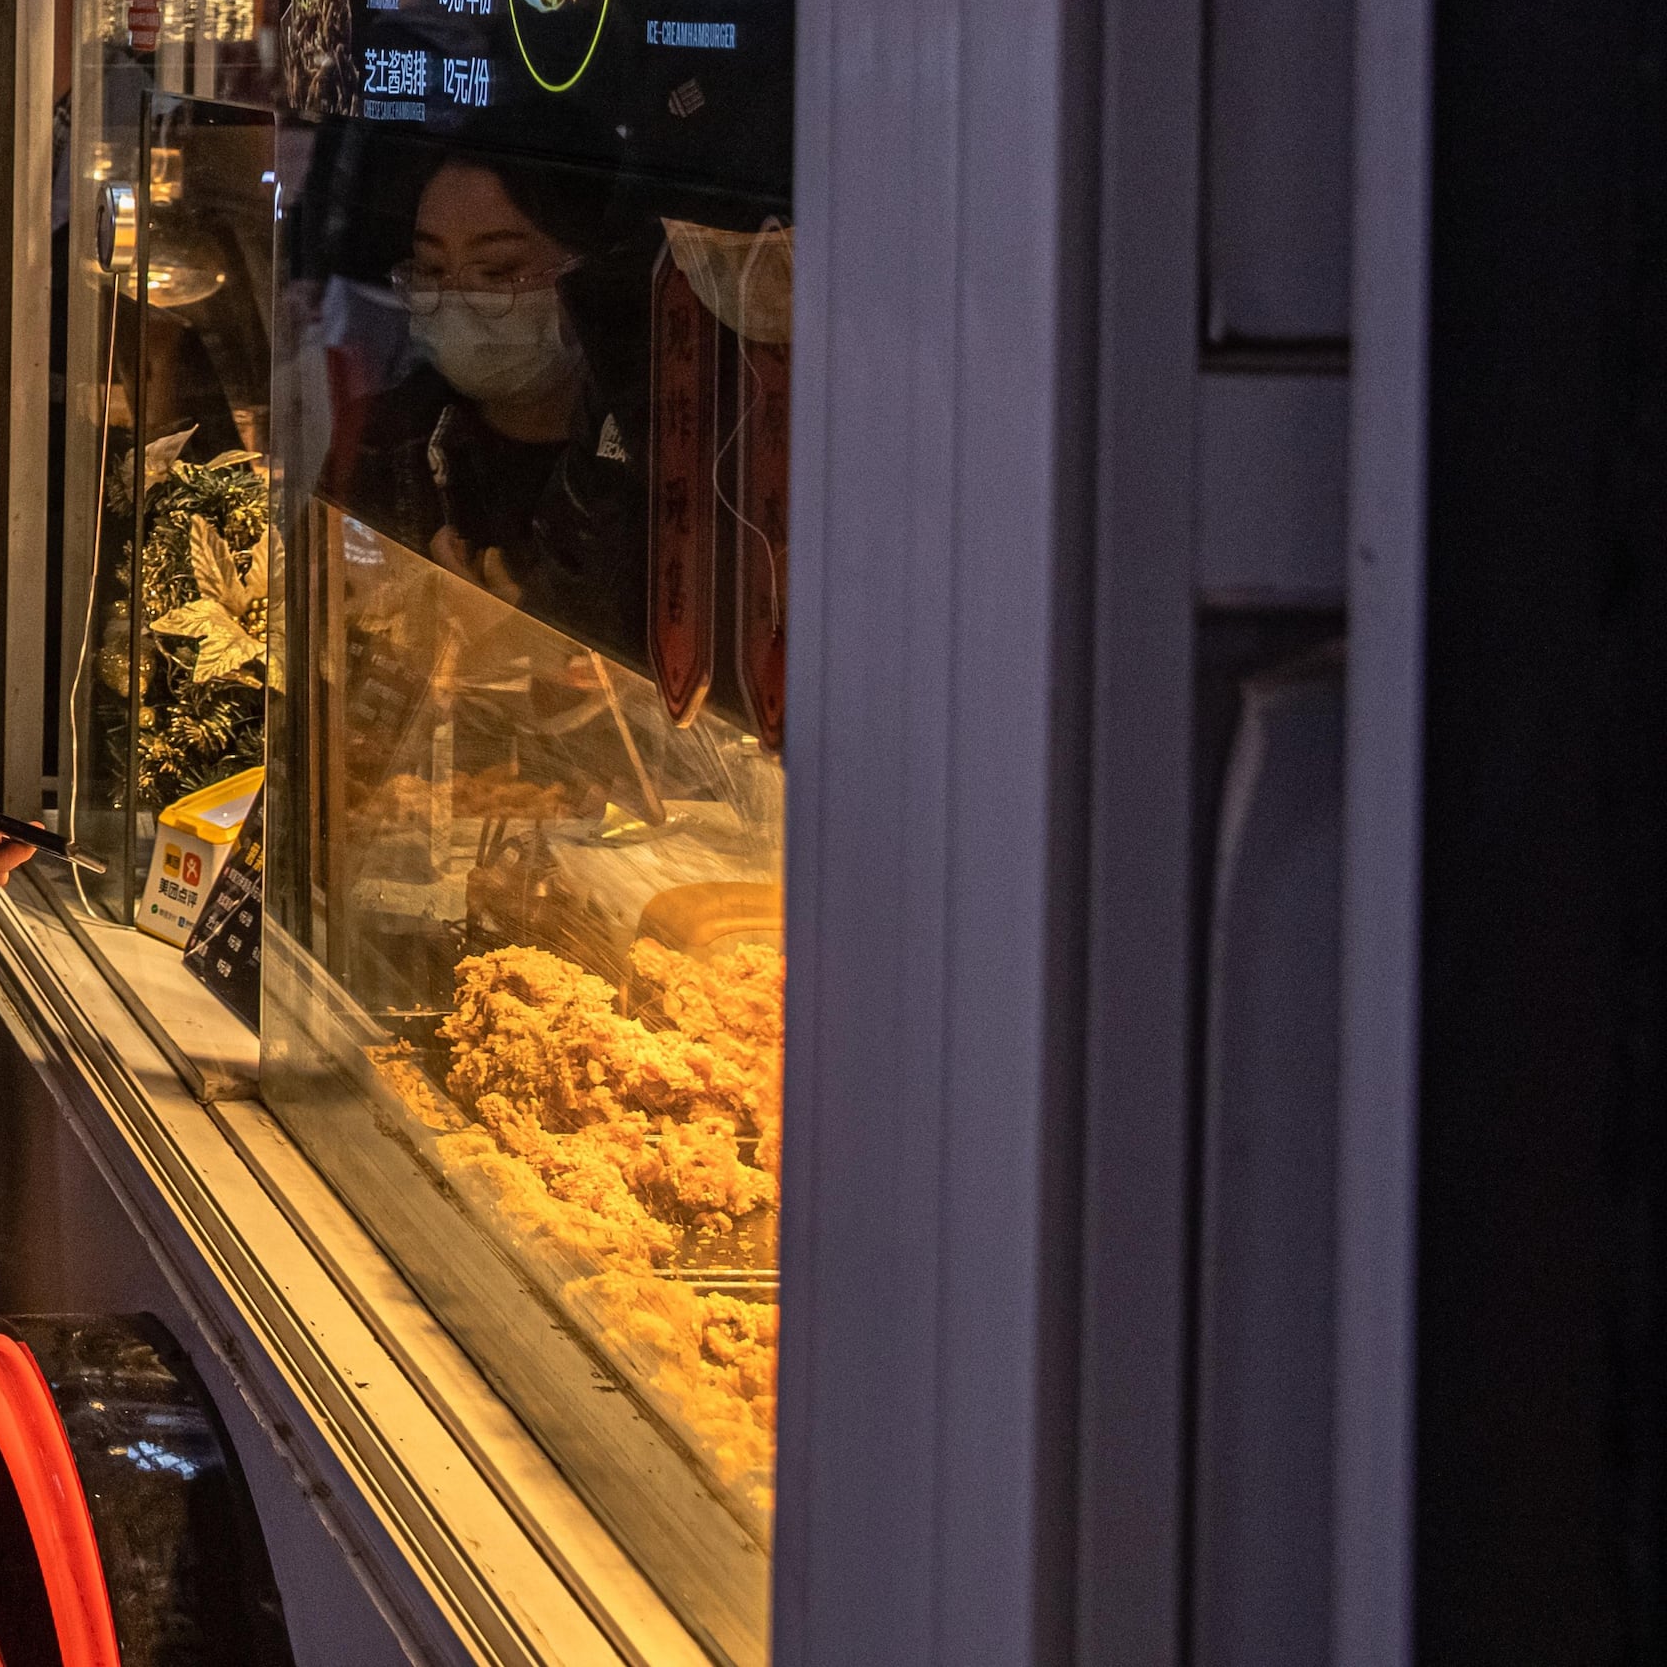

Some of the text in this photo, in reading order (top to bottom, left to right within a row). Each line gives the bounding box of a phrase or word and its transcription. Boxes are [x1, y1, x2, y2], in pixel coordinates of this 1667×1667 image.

[646, 18, 735, 48] ICE-CREAM HAMBURGER
[364, 49, 490, 107] 芝士酱鸡排 12元/份
[158, 878, 198, 908] 美团点评
